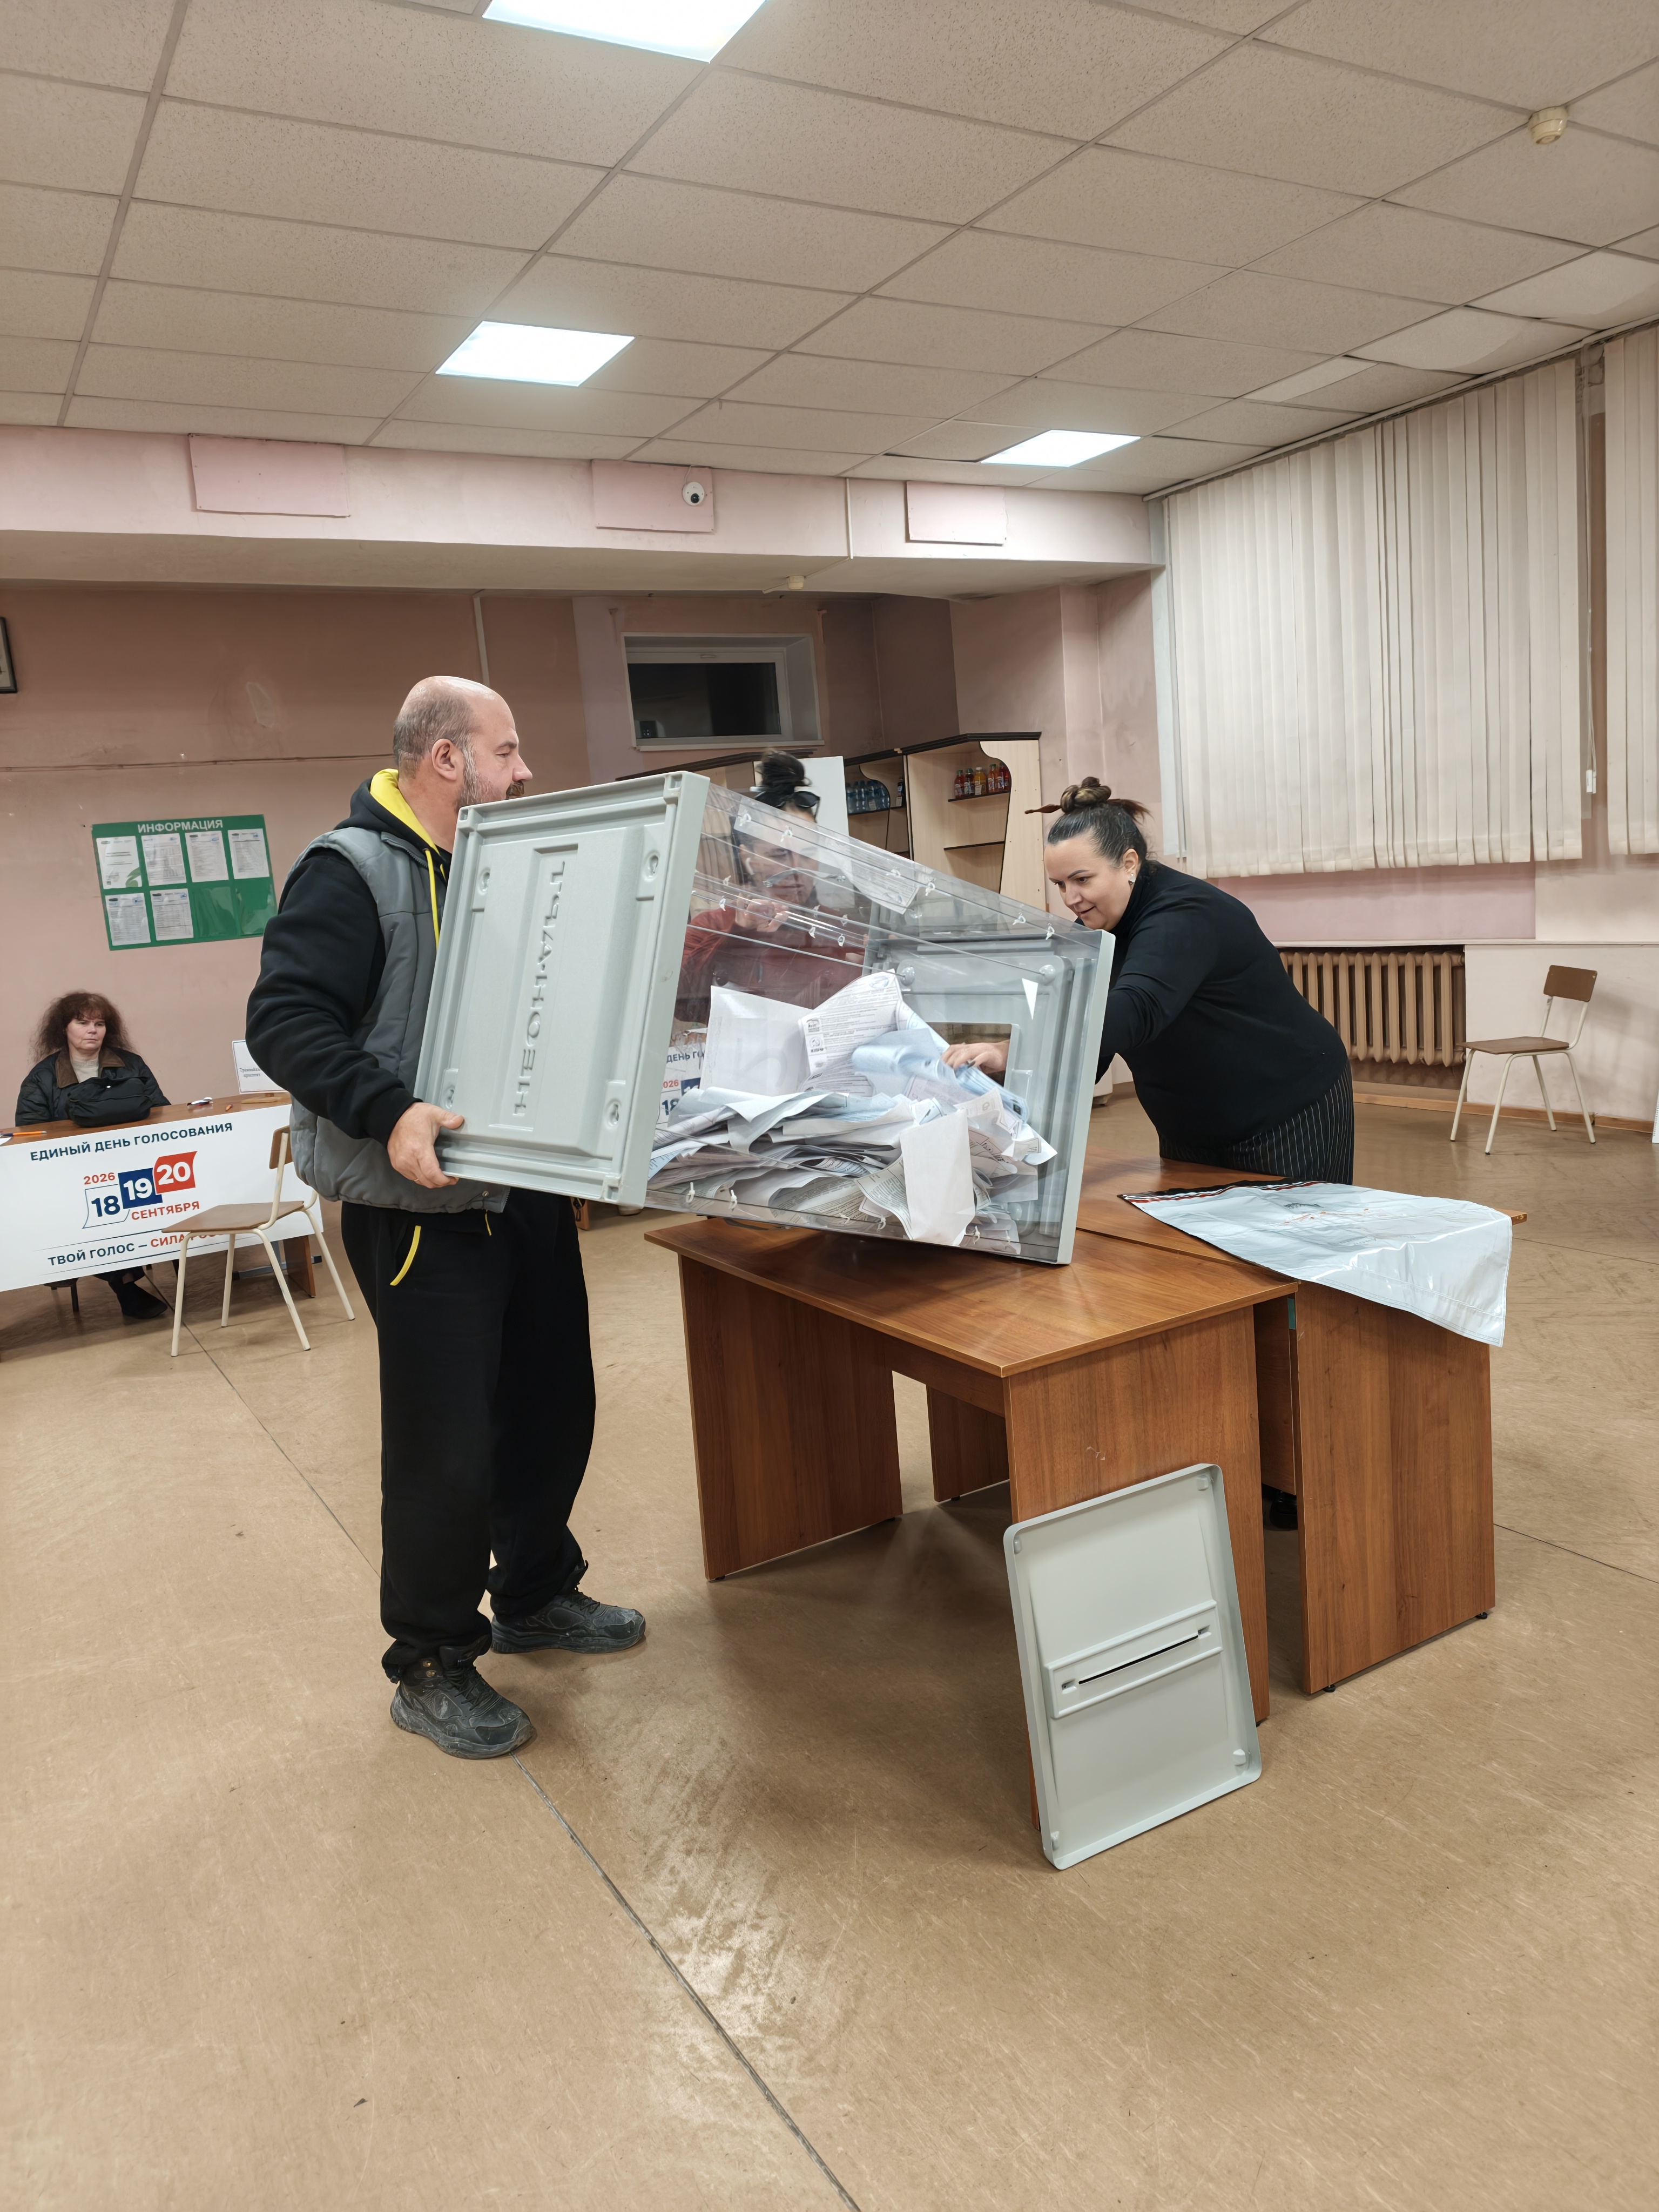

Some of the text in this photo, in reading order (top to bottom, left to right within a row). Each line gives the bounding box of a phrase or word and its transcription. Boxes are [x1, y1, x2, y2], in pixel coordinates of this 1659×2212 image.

[138, 819, 224, 833] ИНФОРМАЦИЯ
[666, 1050, 704, 1063] ДЕНЬ ГО
[662, 1079, 679, 1088] 026
[31, 1123, 233, 1161] ЕДИНЫЙ ДЕНЬ ГОЛОСОВАНИЯ
[84, 1172, 116, 1185] 2026
[91, 1162, 191, 1217] 18 19 20
[132, 1202, 200, 1220] СЕНТЯБРЯ
[48, 1250, 86, 1266] ТВОЙ
[90, 1243, 135, 1258] ГОЛОС
[151, 1235, 185, 1247] СИЛА
